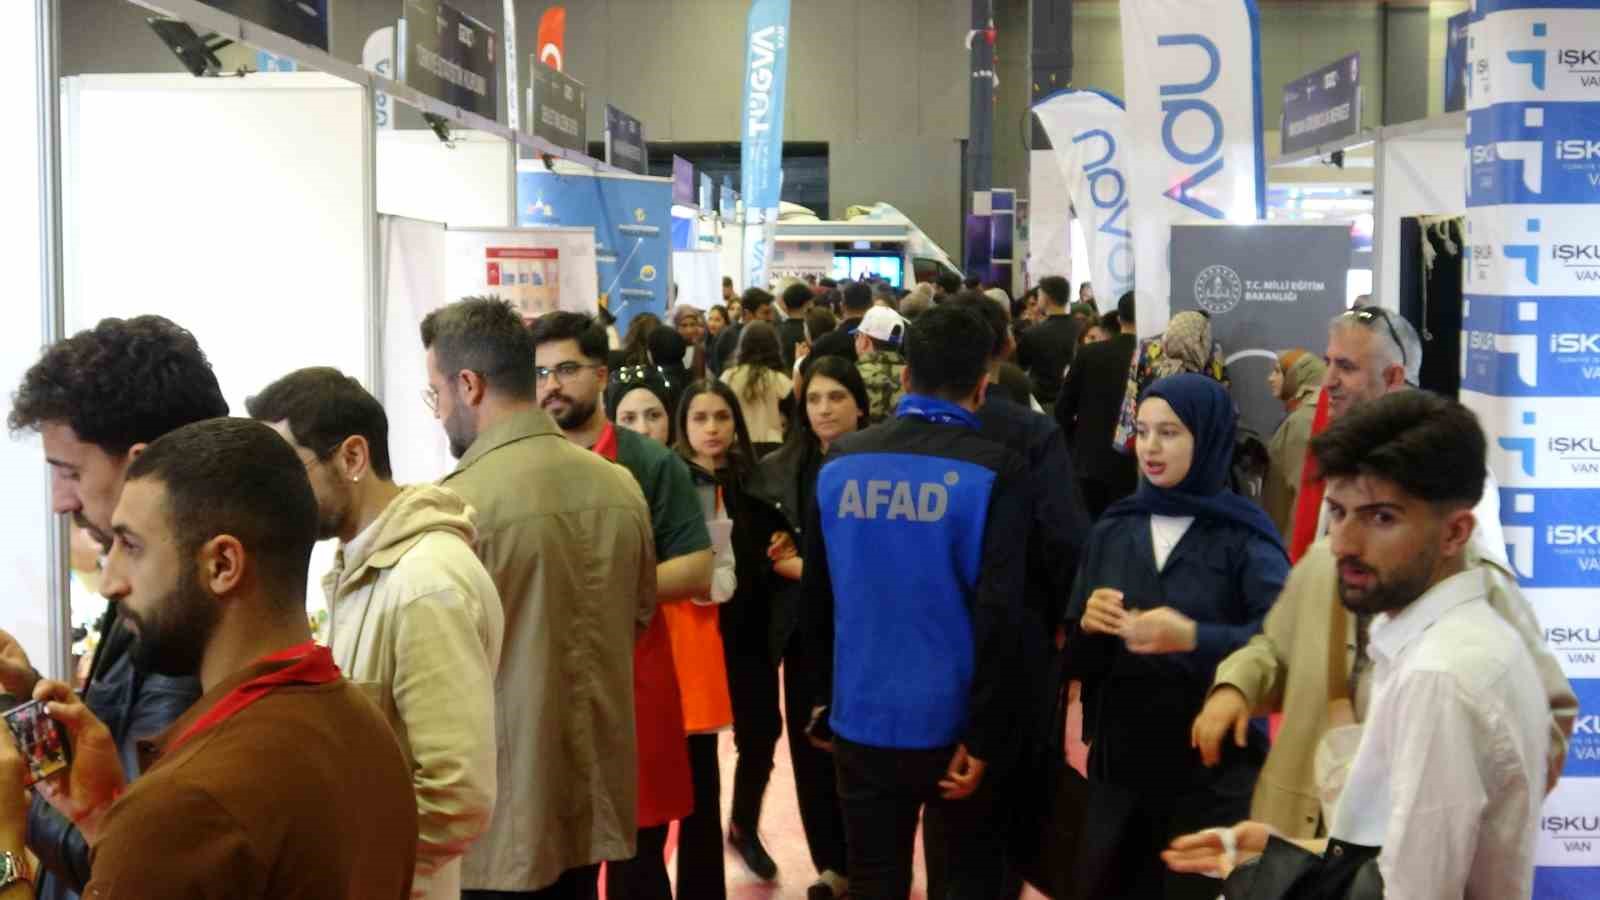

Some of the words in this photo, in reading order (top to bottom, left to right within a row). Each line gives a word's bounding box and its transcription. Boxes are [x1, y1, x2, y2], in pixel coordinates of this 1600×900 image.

[1571, 463, 1599, 473] VAN
[837, 479, 948, 522] AFAD
[1567, 654, 1596, 664] VAN
[1541, 816, 1600, 834] iŞKU
[1564, 841, 1592, 852] VAN
